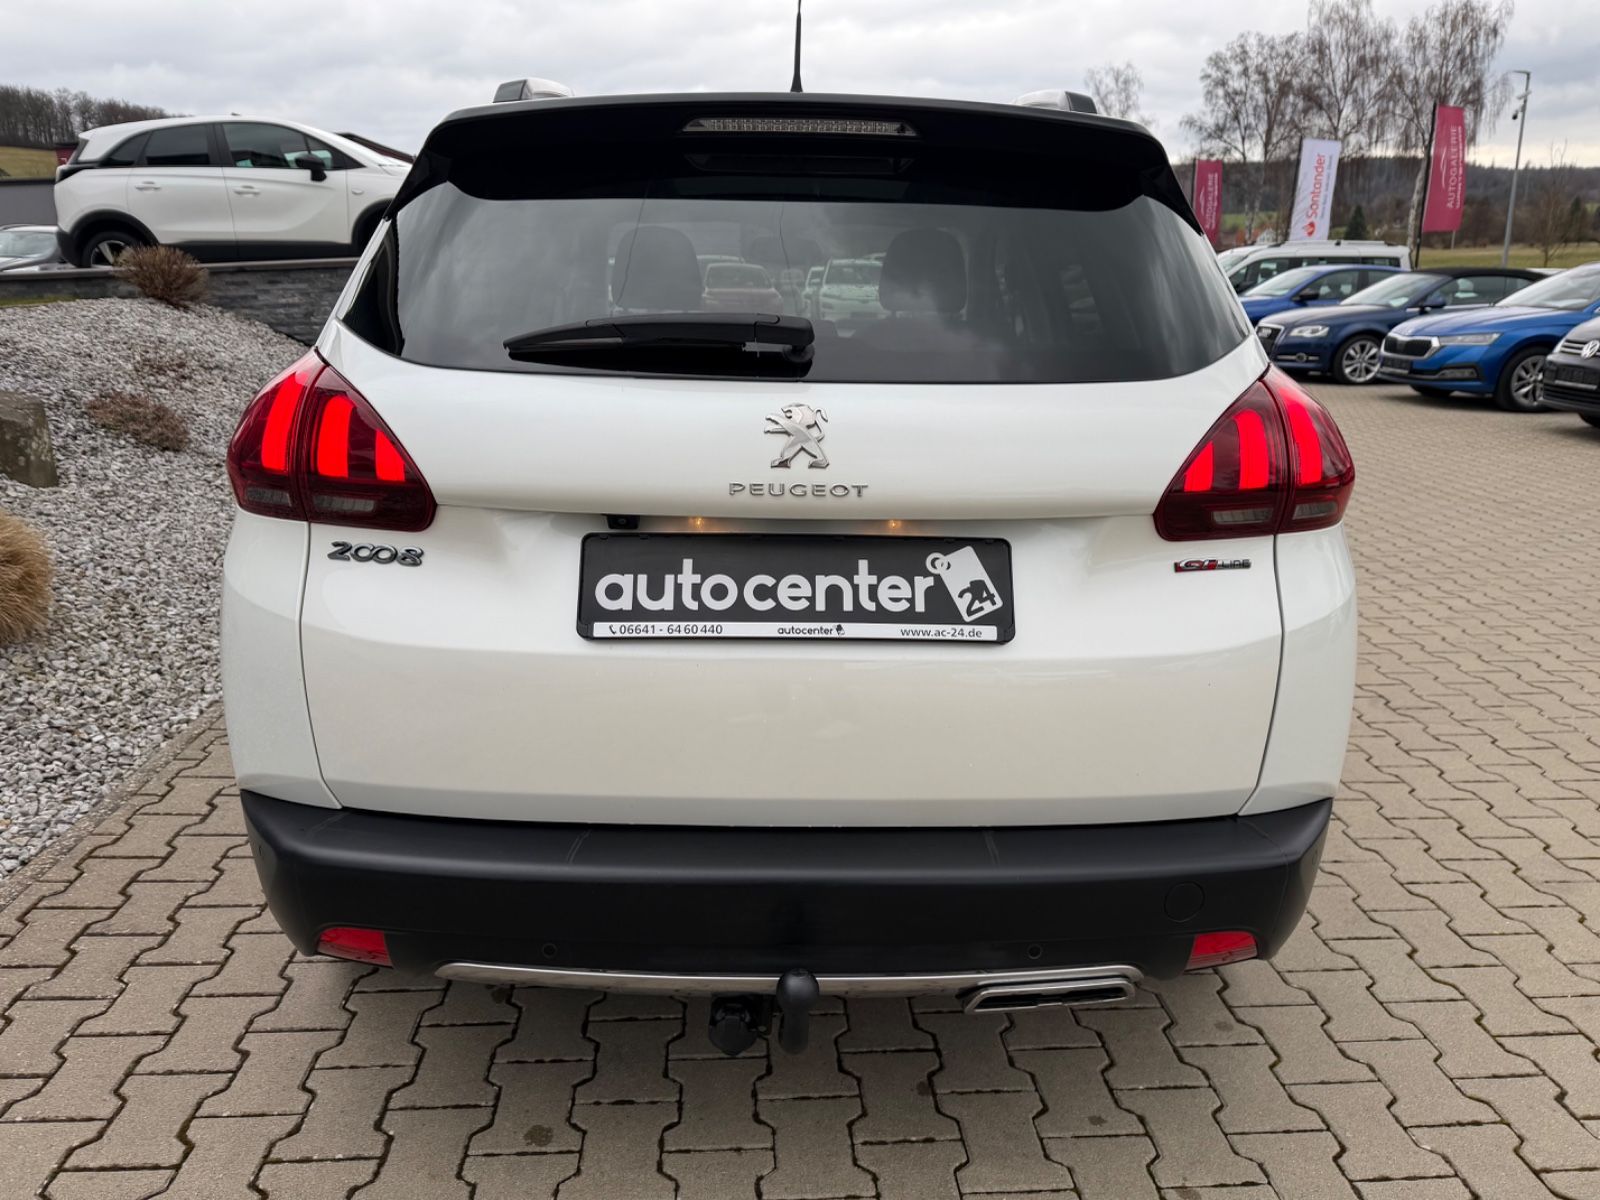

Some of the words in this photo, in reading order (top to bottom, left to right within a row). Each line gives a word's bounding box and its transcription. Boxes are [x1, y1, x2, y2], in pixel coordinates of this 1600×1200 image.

[1446, 125, 1457, 210] AUTOGALERIE
[1306, 152, 1326, 220] Santander
[728, 482, 869, 498] PEUGEOT
[327, 541, 424, 567] 2008
[957, 579, 997, 618] 24
[619, 624, 656, 635] 06641
[777, 625, 834, 635] autocenter
[900, 627, 983, 638] www.ac-24.de
